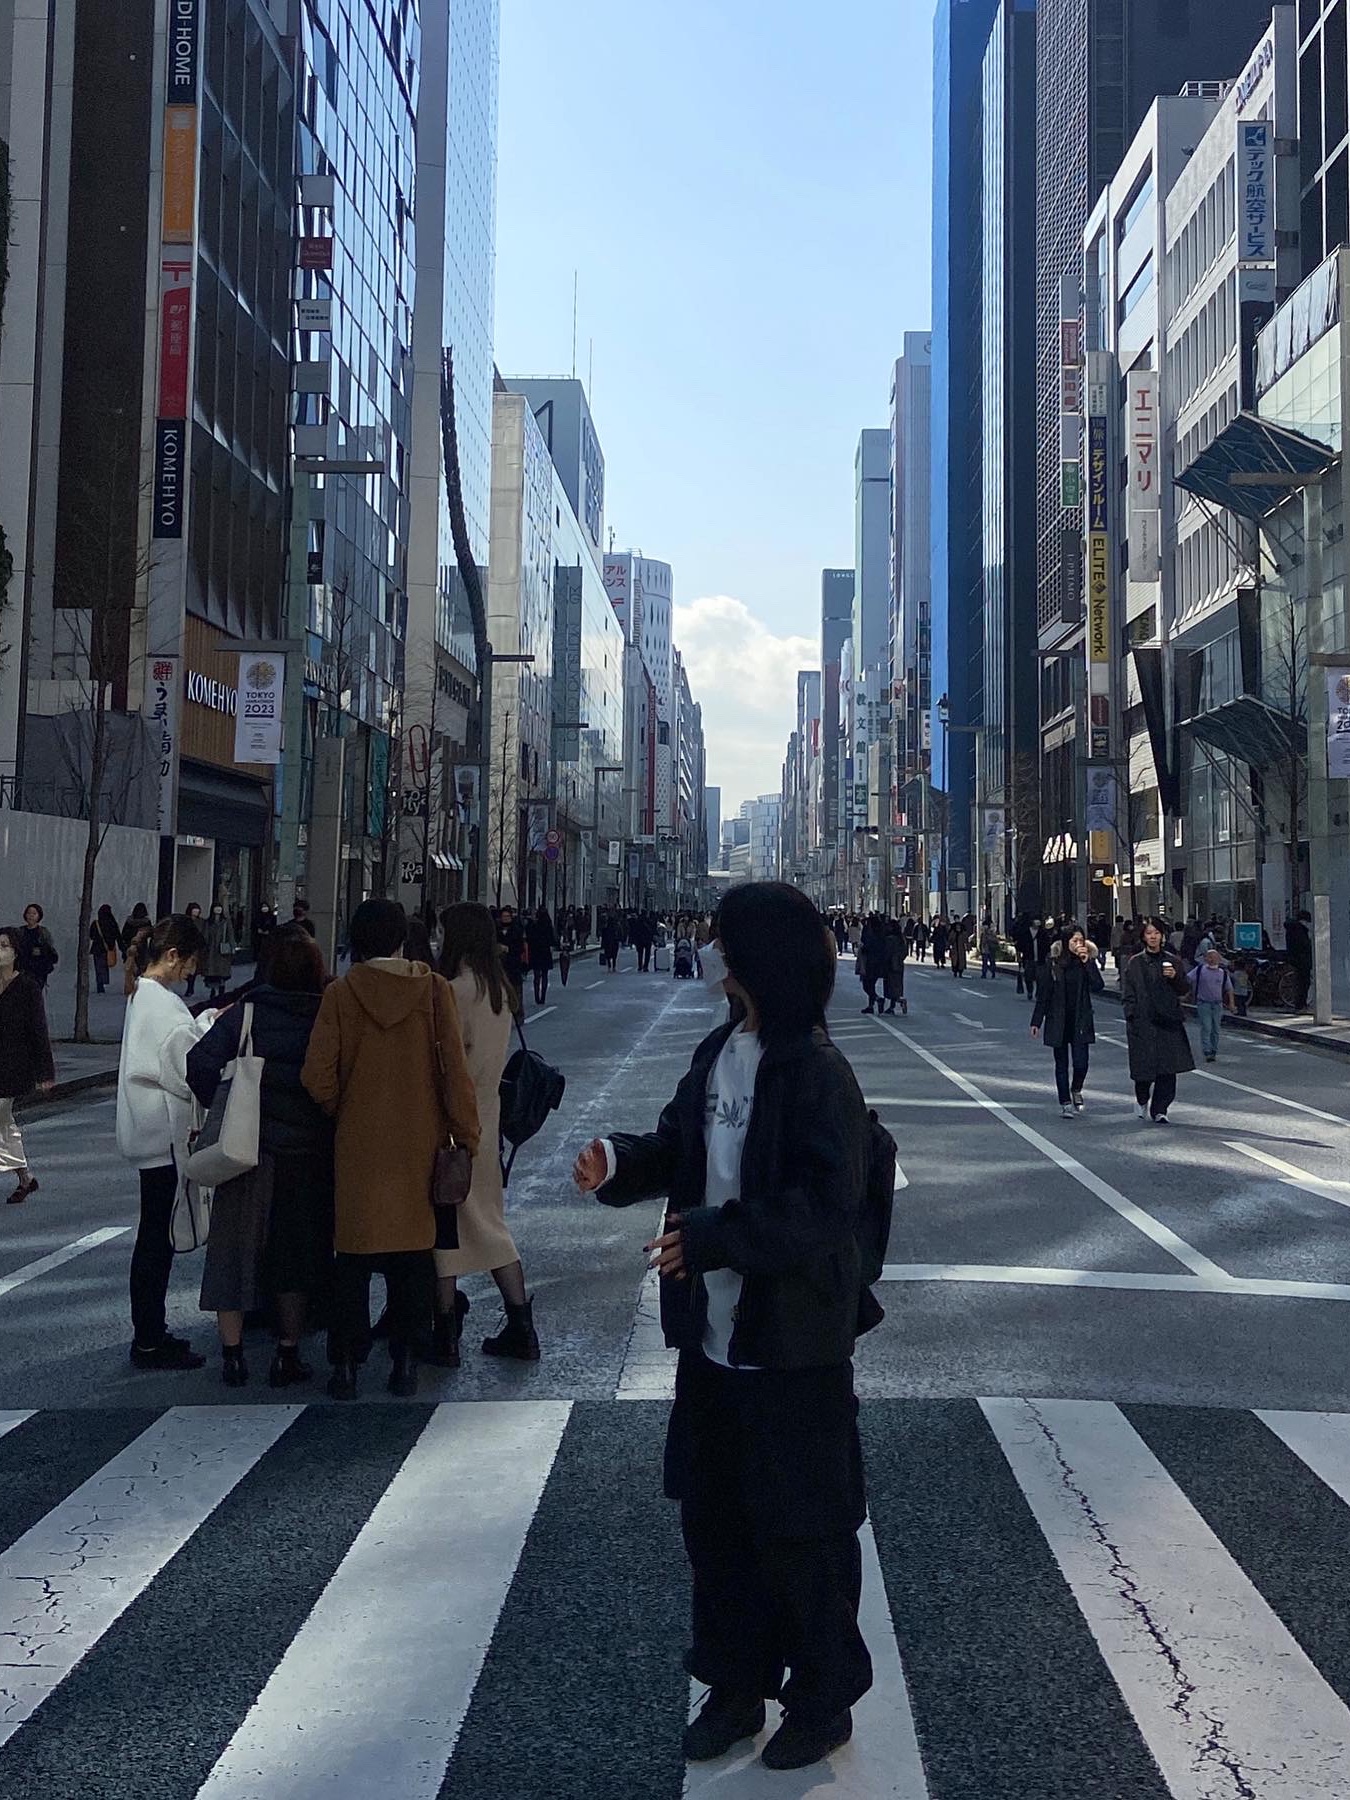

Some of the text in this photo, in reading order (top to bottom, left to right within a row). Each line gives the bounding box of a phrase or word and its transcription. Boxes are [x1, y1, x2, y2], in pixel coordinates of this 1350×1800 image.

[1245, 149, 1266, 257] テック航空サービス
[1134, 390, 1153, 491] エニマリ
[161, 429, 178, 526] KOMEHYO
[603, 565, 627, 575] アル
[1093, 537, 1105, 581] ELITE
[187, 669, 238, 717] KOMEHYO
[245, 704, 275, 714] 2023
[246, 691, 275, 699] TOKYO
